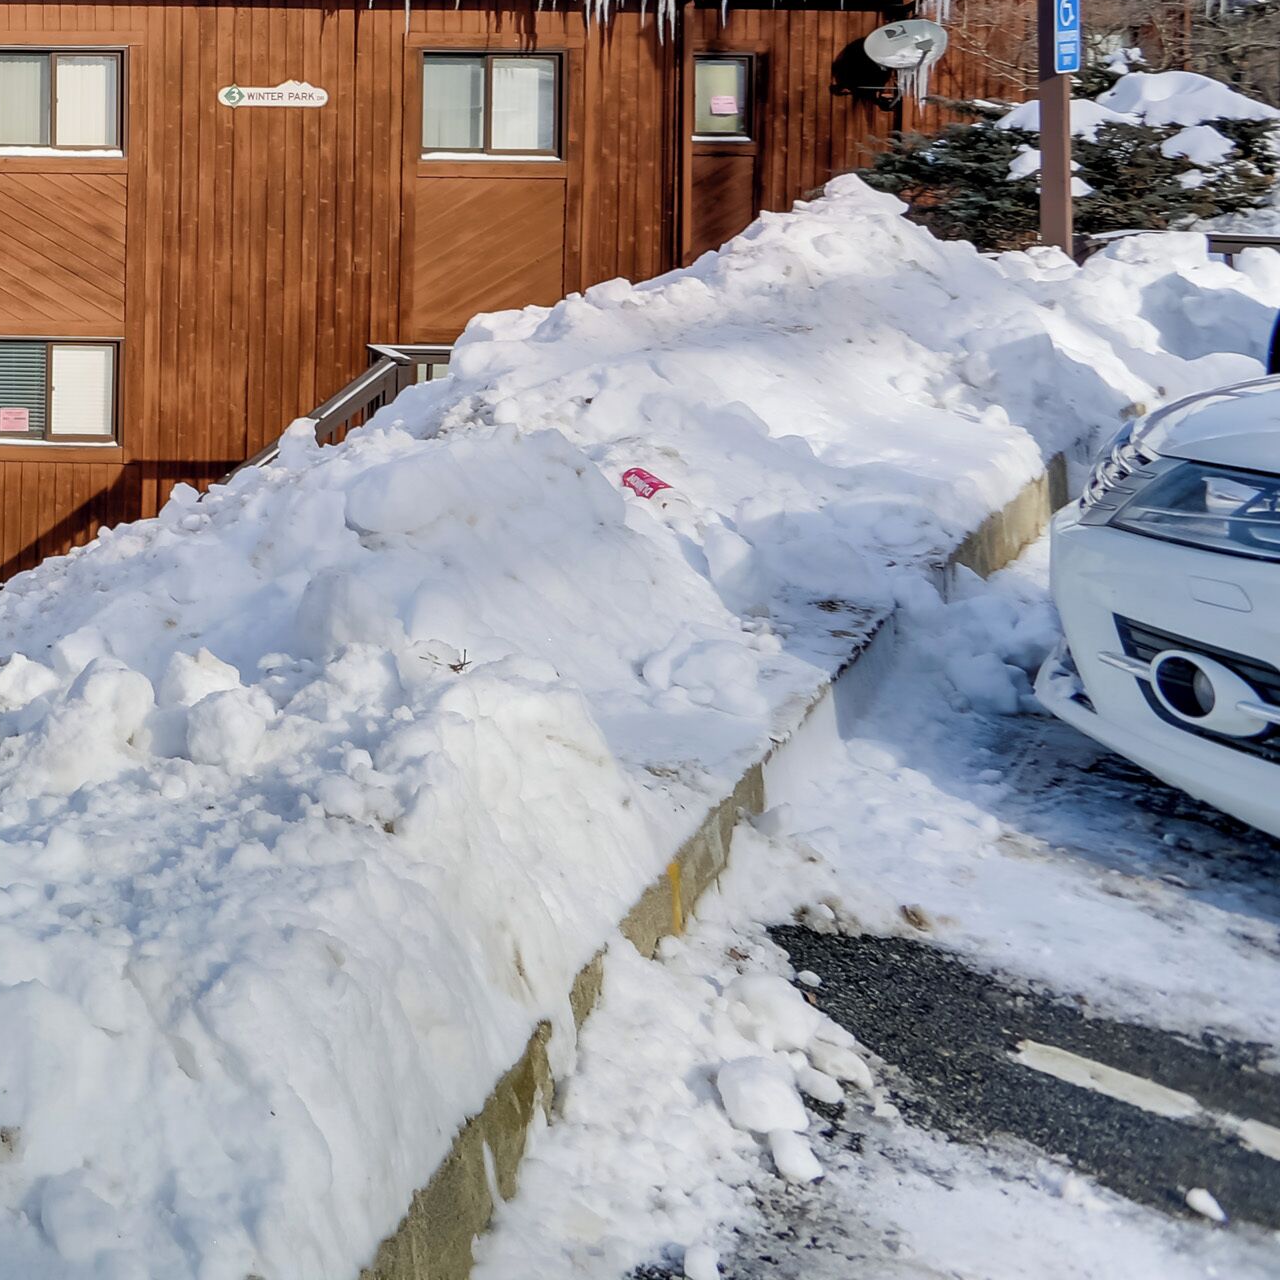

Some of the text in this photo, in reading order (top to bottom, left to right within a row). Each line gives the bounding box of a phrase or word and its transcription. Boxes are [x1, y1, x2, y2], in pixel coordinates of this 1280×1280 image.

[229, 88, 240, 103] 3
[247, 92, 284, 101] WINTER
[288, 92, 315, 101] PARK
